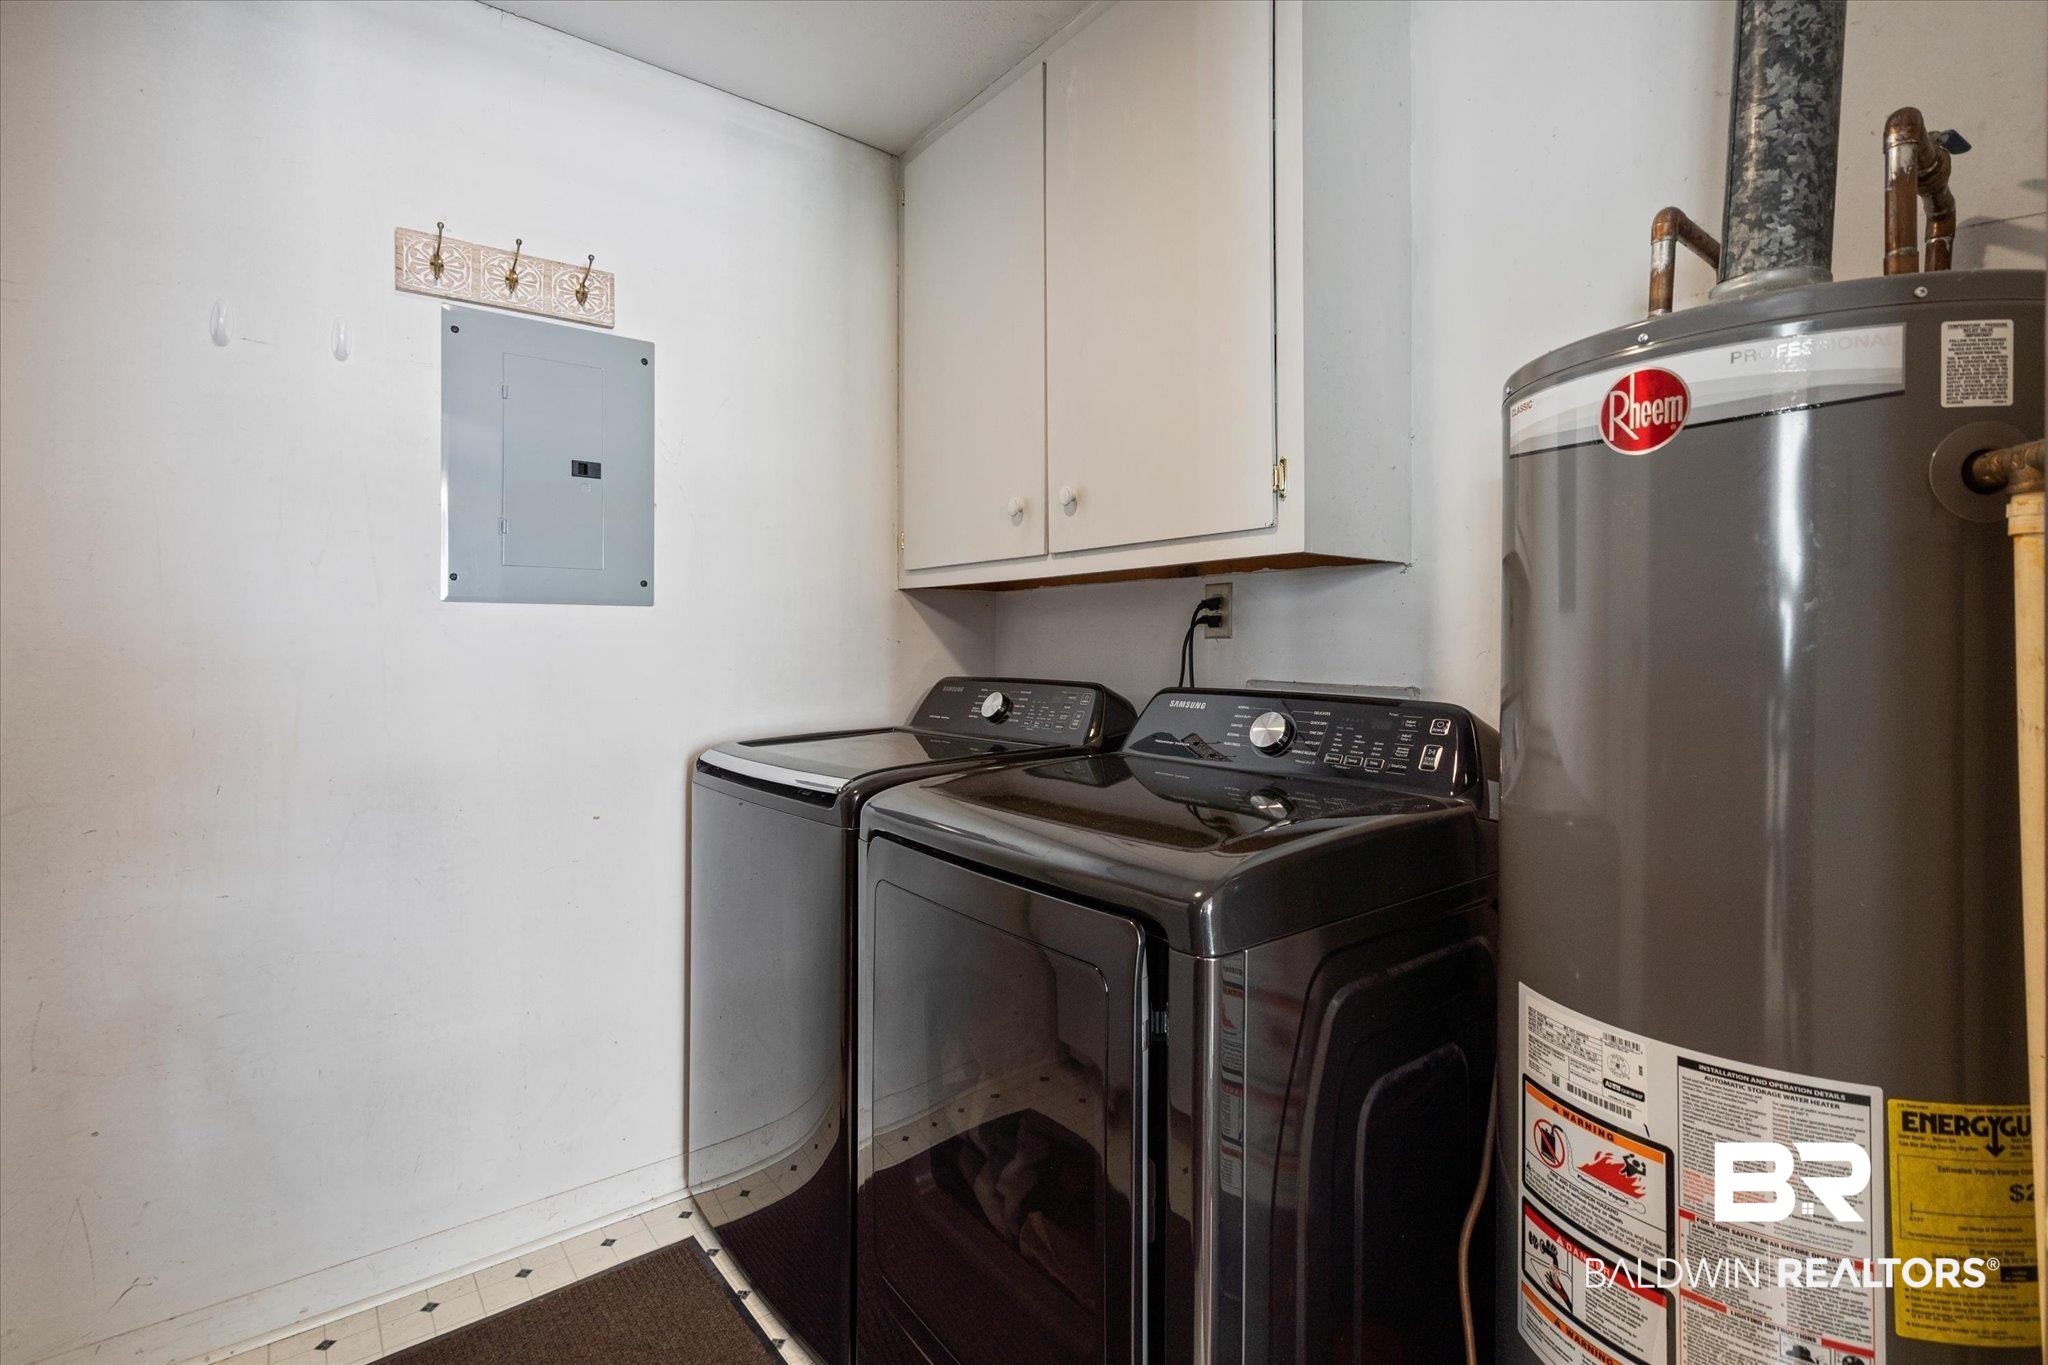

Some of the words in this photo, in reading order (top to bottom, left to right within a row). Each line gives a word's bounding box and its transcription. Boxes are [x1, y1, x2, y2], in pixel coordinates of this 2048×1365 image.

[1511, 401, 1533, 419] CLASSIC
[1608, 371, 1684, 442] Rheem
[1169, 700, 1207, 710] SAMSUNG
[1699, 1064, 1749, 1083] INSTALLATION
[1750, 1076, 1768, 1087] AND
[1769, 1080, 1813, 1096] OPERATION
[1814, 1089, 1846, 1101] DETAILS
[1704, 1075, 1746, 1091] AUTOMATIC
[1747, 1086, 1782, 1099] STORAGE
[1783, 1093, 1809, 1105] WATER
[1810, 1098, 1841, 1110] HEATER
[1563, 1110, 1615, 1143] WARNING
[1902, 1110, 2032, 1150] ENERGYGU
[1937, 1166, 1972, 1175] Estimated
[1974, 1168, 1996, 1178] Yearly
[1997, 1169, 2019, 1178] Energy
[1569, 1182, 1596, 1204] EXPLOSION
[1596, 1199, 1619, 1216] HAZARD
[1577, 1173, 1607, 1194] Flammable
[1608, 1190, 1630, 1206] Vapors
[2009, 1183, 2035, 1203] $2
[1696, 1217, 1710, 1226] FOR
[1711, 1221, 1730, 1234] YOUR
[1731, 1227, 1759, 1242] SAFETY
[1760, 1238, 1780, 1248] READ
[1781, 1243, 1809, 1258] BEFORE
[1811, 1252, 1853, 1267] OPERAT
[1730, 1310, 1763, 1326] LIGHTING
[1764, 1321, 1818, 1343] INSTRUCTIONS
[1567, 1327, 1614, 1365] WARNING
